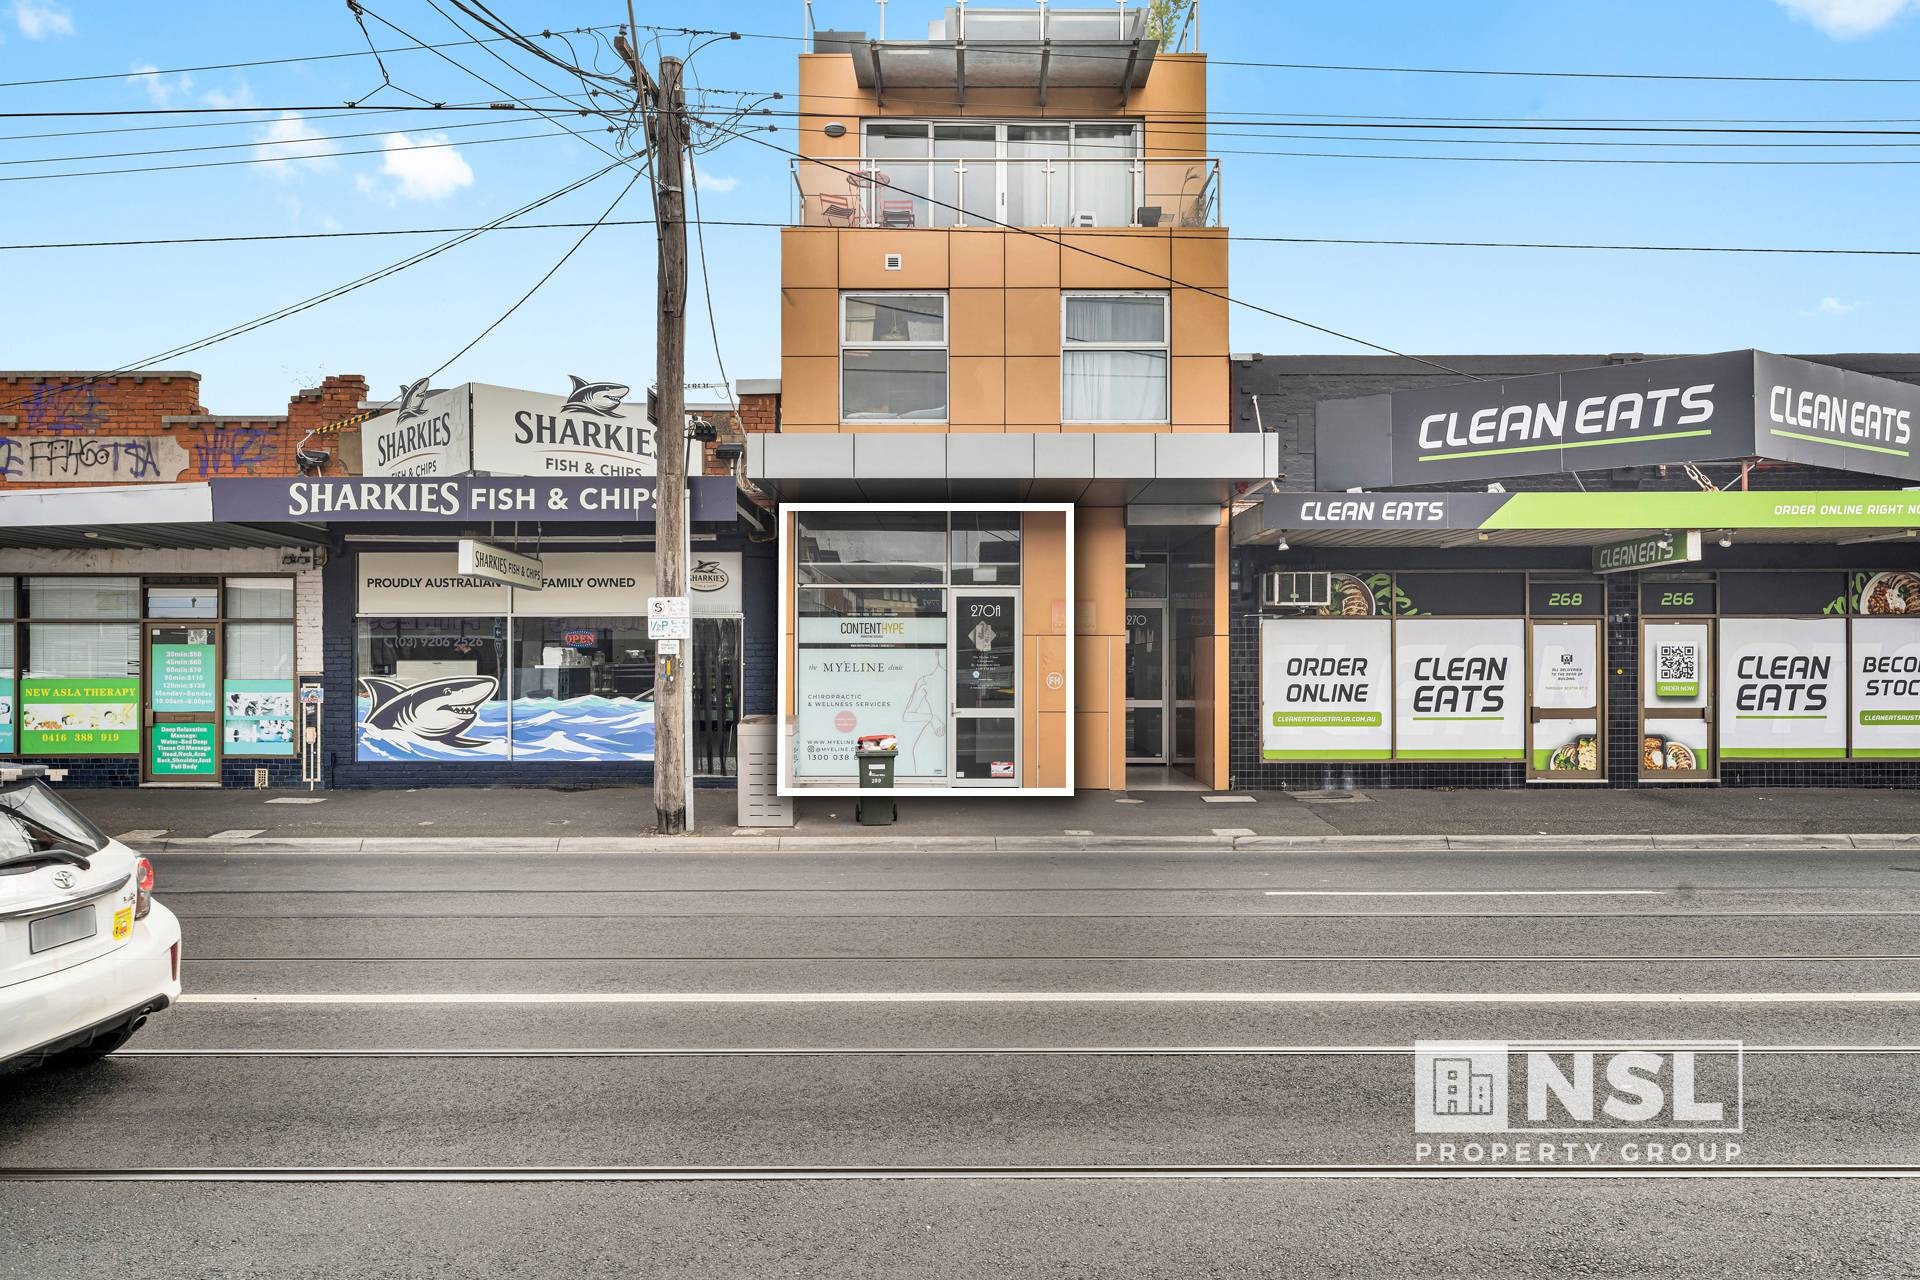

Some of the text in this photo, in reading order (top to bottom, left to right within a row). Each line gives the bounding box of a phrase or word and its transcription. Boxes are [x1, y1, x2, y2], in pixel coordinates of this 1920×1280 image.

[1419, 383, 1715, 449] CLEAN EATS
[1769, 385, 1912, 445] CLEAN EATS
[377, 412, 451, 467] SHARKIES
[514, 410, 658, 460] SHARKIE
[416, 460, 437, 477] CHIPS
[546, 457, 579, 473] FISH
[585, 462, 595, 475] &
[288, 482, 460, 516] SHARKIES
[471, 488, 536, 510] FISH
[547, 487, 569, 511] &
[1300, 502, 1444, 521] CLEAN EATS
[1774, 504, 1816, 515] ORDER
[1820, 504, 1863, 515] ONLINE
[1867, 504, 1904, 515] RIGHT
[475, 550, 507, 575] SHARKIES
[508, 562, 520, 576] FISH
[526, 567, 541, 581] CHIPS
[1600, 544, 1638, 568] CLEAN
[367, 578, 423, 588] PROUDLY
[541, 578, 584, 588] FAMILY
[587, 578, 636, 588] OWNED
[1549, 593, 1583, 606] 268
[1661, 593, 1694, 606] 266
[970, 604, 1001, 617] 270A
[1126, 614, 1147, 626] 270
[394, 637, 484, 649] (03) 9206 2526
[564, 633, 595, 645] OPEN
[1286, 657, 1368, 676] ORDER
[1414, 657, 1508, 681] CLEAN
[1737, 655, 1831, 680] CLEAN
[1862, 656, 1920, 673] BECO
[25, 688, 51, 697] NEW
[83, 687, 136, 697] THERAPY
[1286, 683, 1369, 702] ONLINE
[1413, 685, 1504, 712] EATS
[1736, 684, 1828, 711] EATS
[42, 733, 67, 742] 0416
[74, 733, 94, 742] 388
